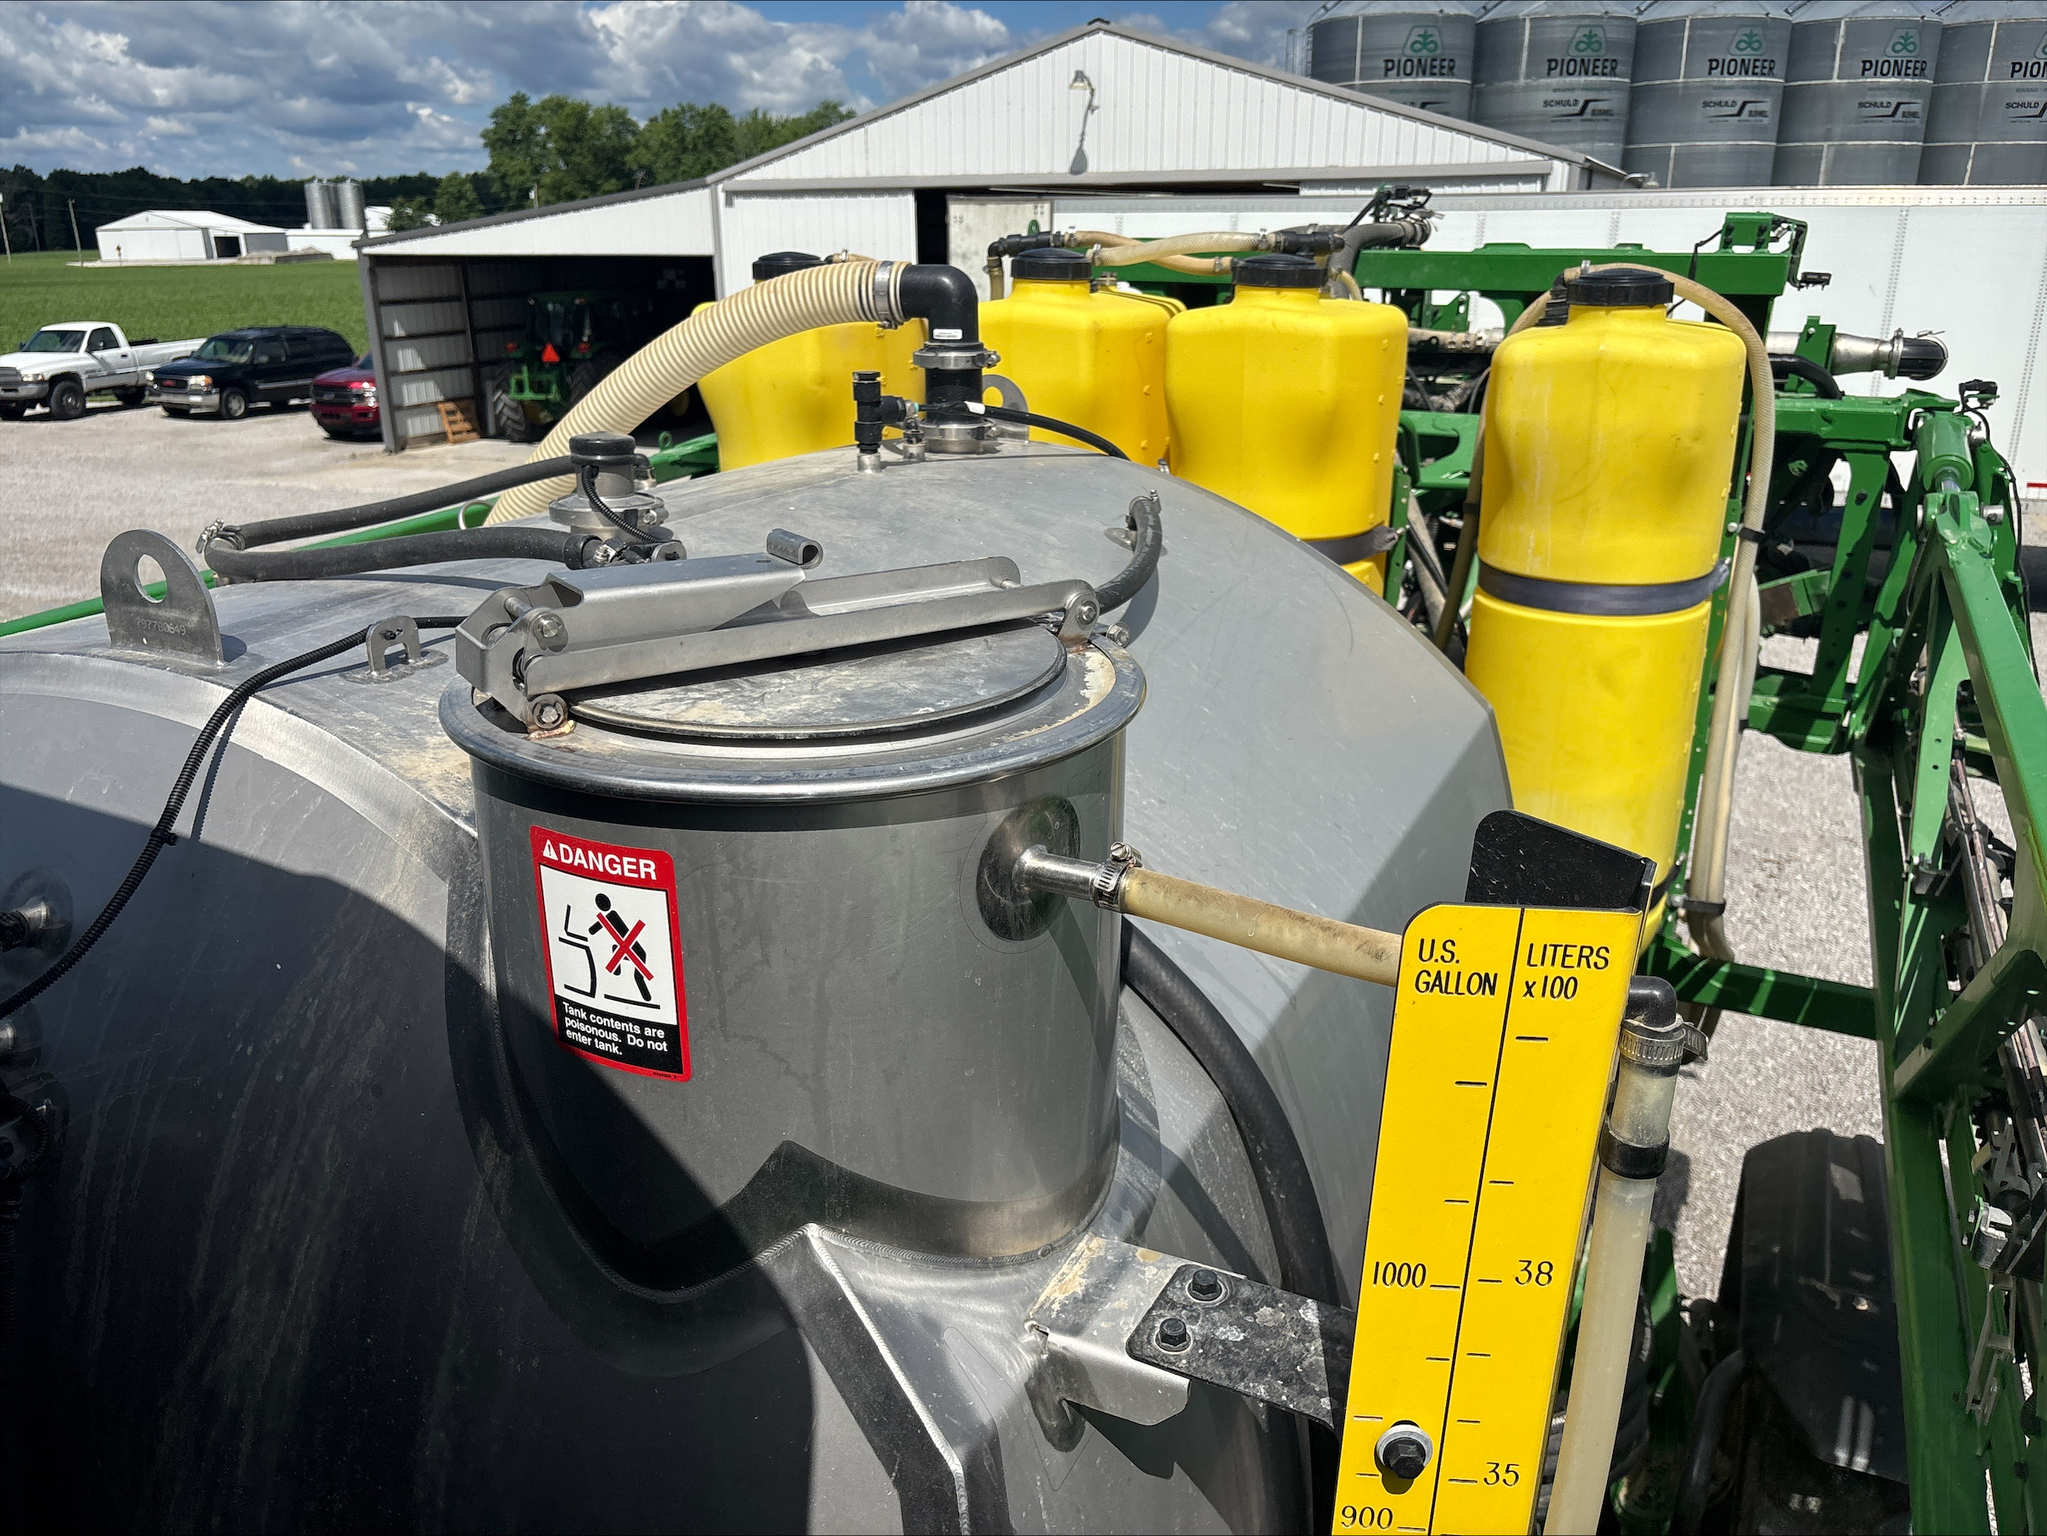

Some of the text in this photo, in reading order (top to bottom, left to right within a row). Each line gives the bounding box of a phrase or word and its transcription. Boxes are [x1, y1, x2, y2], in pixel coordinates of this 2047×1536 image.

[1383, 58, 1456, 77] PIONEER
[1546, 58, 1618, 77] PIONEER
[1707, 58, 1776, 77] PIONEER
[1861, 59, 1928, 77] PIONEER
[2005, 101, 2040, 109] SCHULD
[559, 843, 657, 880] DANGER
[1417, 939, 1460, 964] U.S.
[1526, 943, 1610, 970] LITERS
[1414, 970, 1497, 997] GALLON
[562, 1001, 665, 1039] Tank contents are
[564, 1017, 668, 1052] poisonous. Do not
[566, 1029, 623, 1055] enter tank.
[1373, 1261, 1426, 1289] 1000
[1514, 1260, 1554, 1287] 38
[1482, 1463, 1520, 1487] 35
[1340, 1506, 1394, 1530] 900
